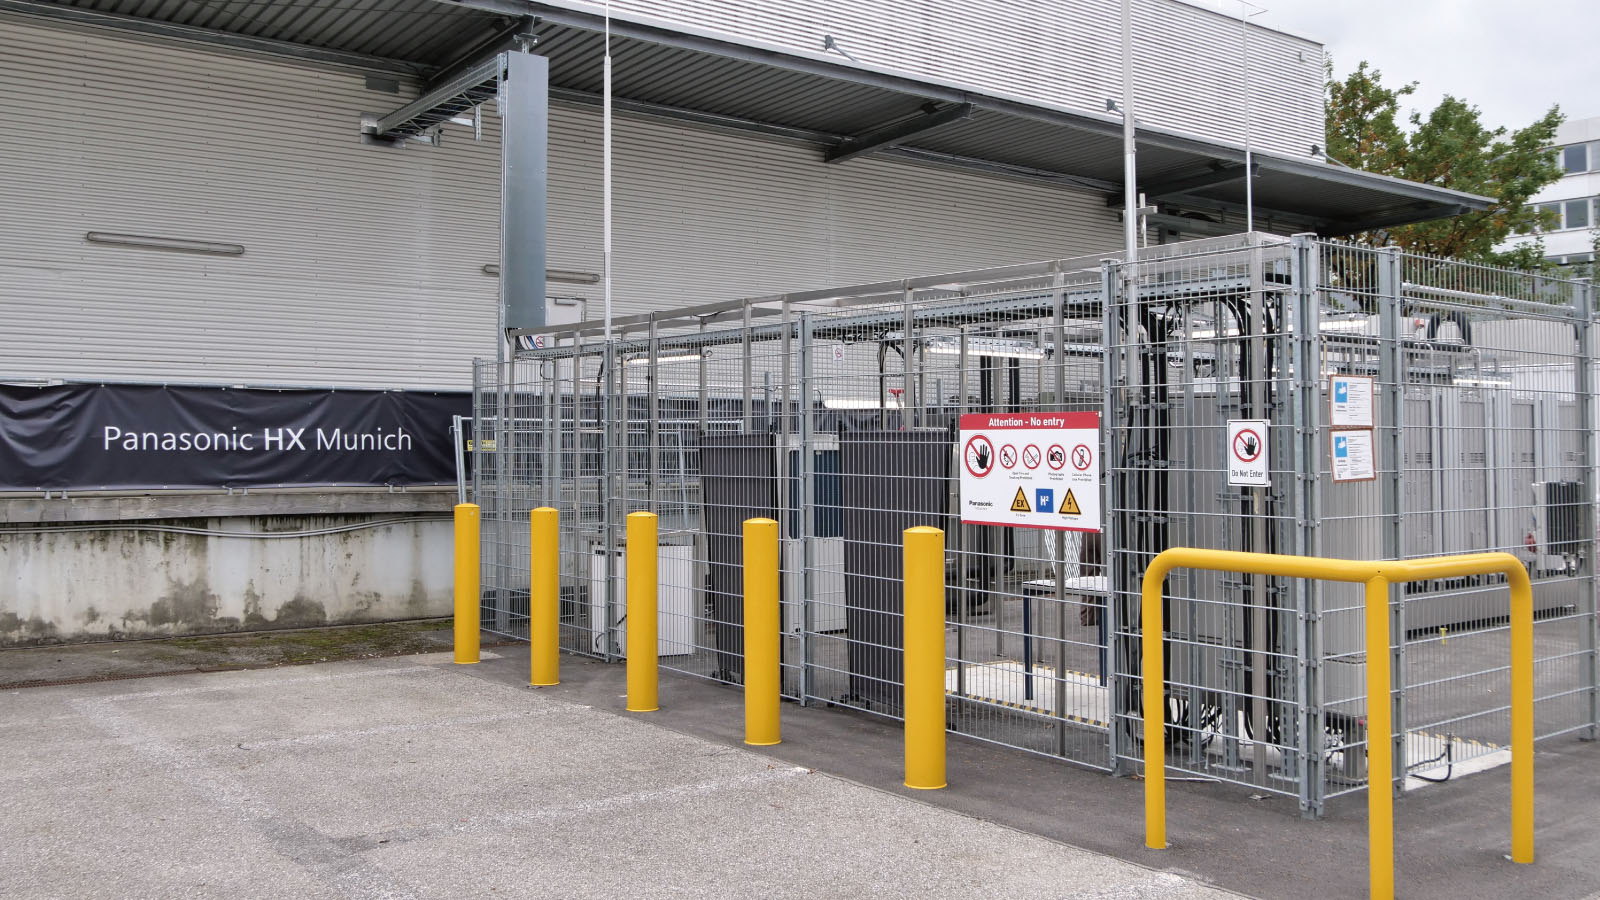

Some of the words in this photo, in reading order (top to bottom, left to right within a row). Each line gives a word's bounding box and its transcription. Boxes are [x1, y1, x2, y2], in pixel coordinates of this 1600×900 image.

[988, 417, 1023, 427] Attention
[1030, 417, 1041, 427] No
[1043, 417, 1065, 428] entry
[104, 426, 253, 450] Panasonic
[264, 428, 306, 450] HX
[317, 427, 412, 450] Munich
[1016, 499, 1025, 508] EX
